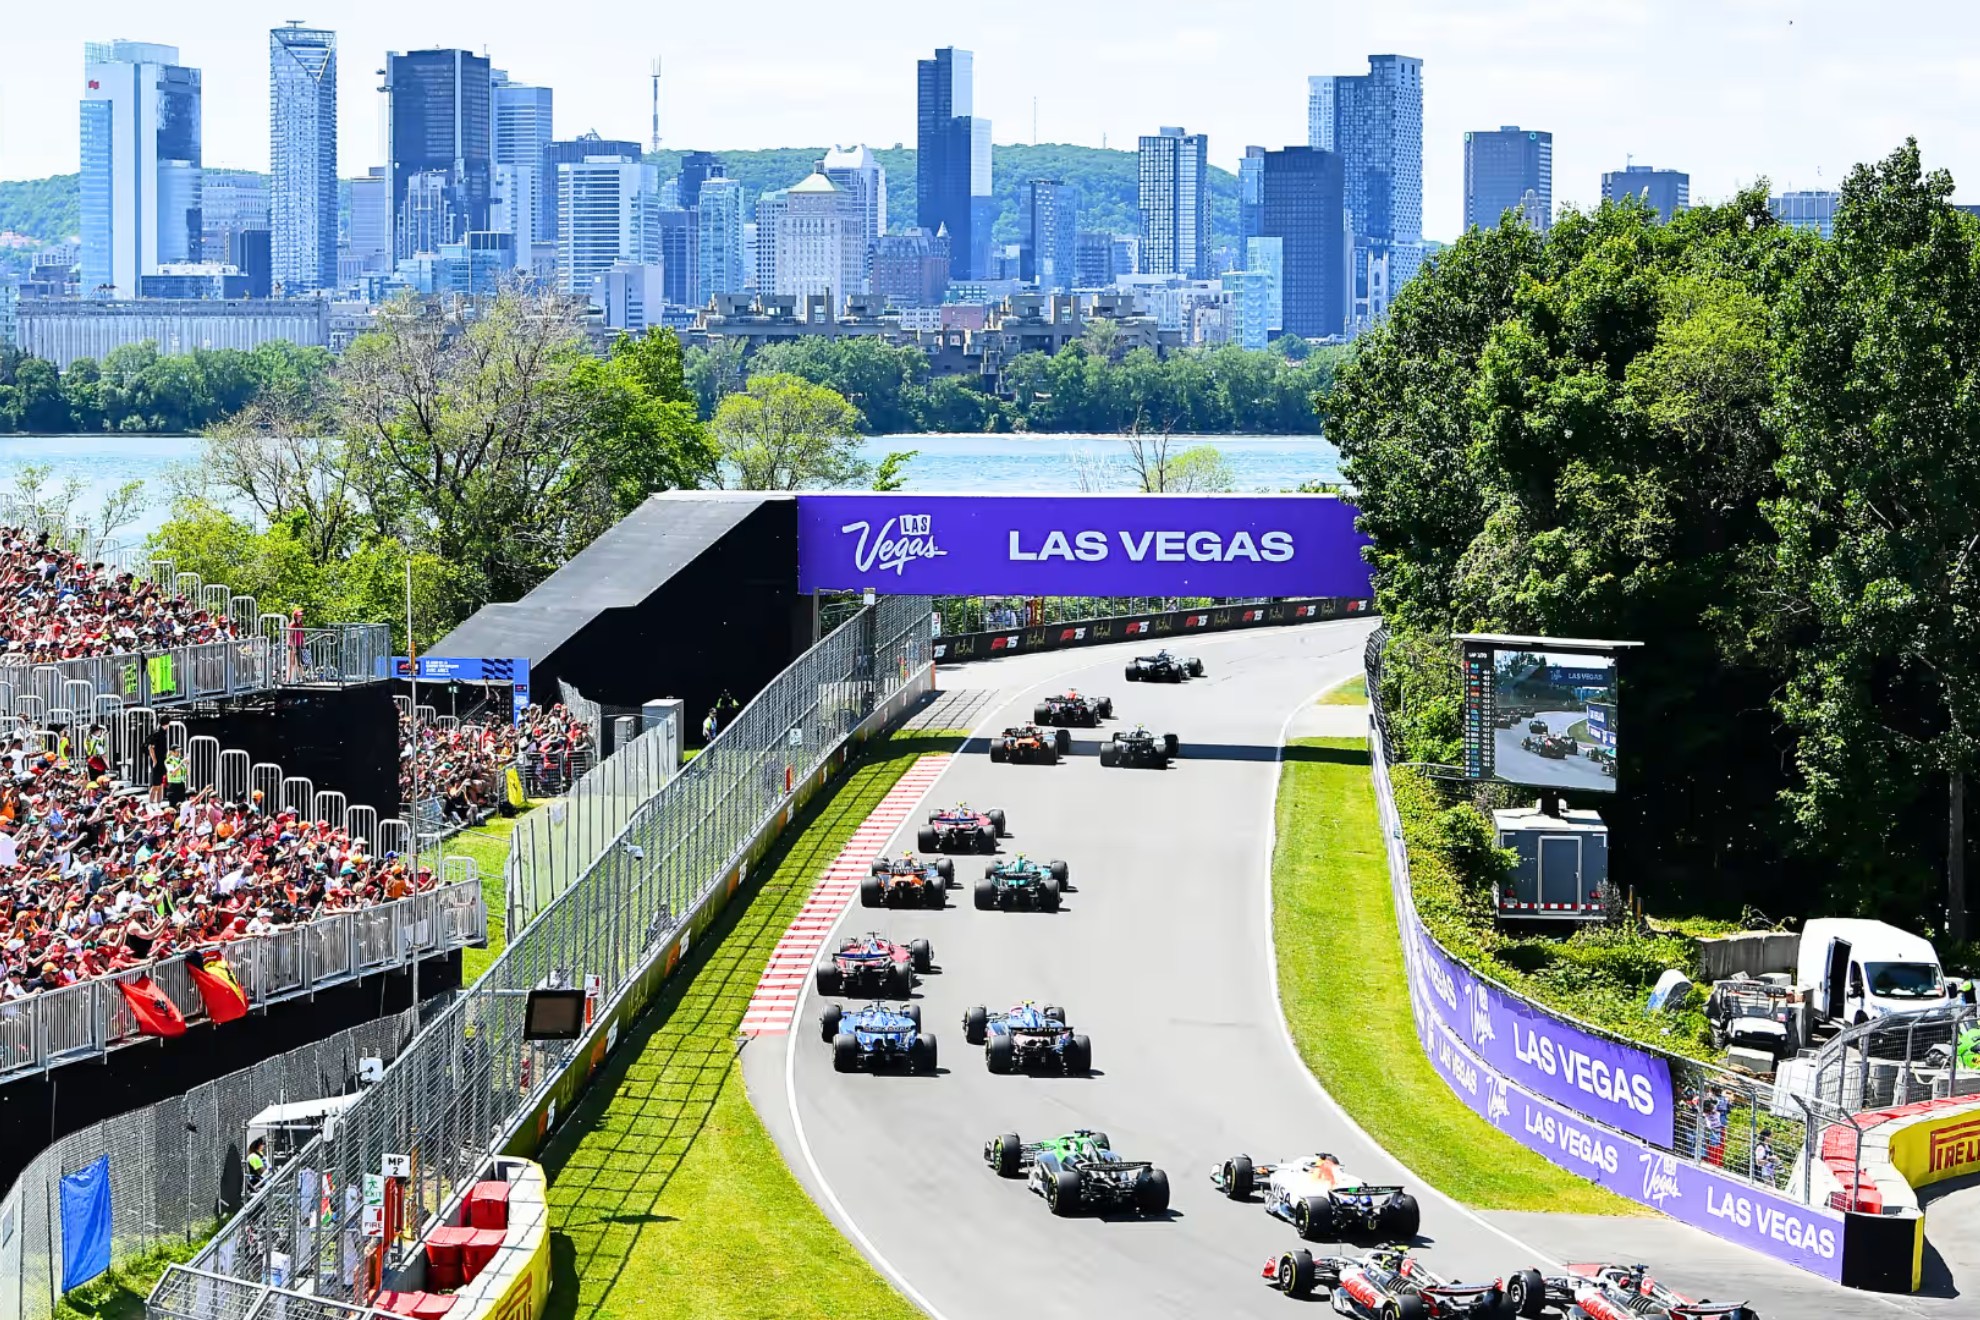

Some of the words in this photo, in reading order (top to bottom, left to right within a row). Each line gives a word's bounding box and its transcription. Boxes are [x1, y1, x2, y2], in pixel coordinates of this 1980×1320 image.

[901, 516, 930, 534] LAS
[842, 518, 948, 576] Vegas
[1009, 530, 1109, 562] LAS
[1118, 530, 1295, 562] VEGAS
[1513, 1021, 1557, 1076] LAS
[1558, 1043, 1655, 1116] VEGAS
[1525, 1104, 1556, 1144] LAS
[1558, 1121, 1619, 1174] VEGAS
[388, 1157, 405, 1166] MP
[392, 1167, 399, 1175] 2
[364, 1221, 383, 1229] FIRE
[1707, 1185, 1751, 1227] LAS
[1755, 1203, 1835, 1259] VEGAS
